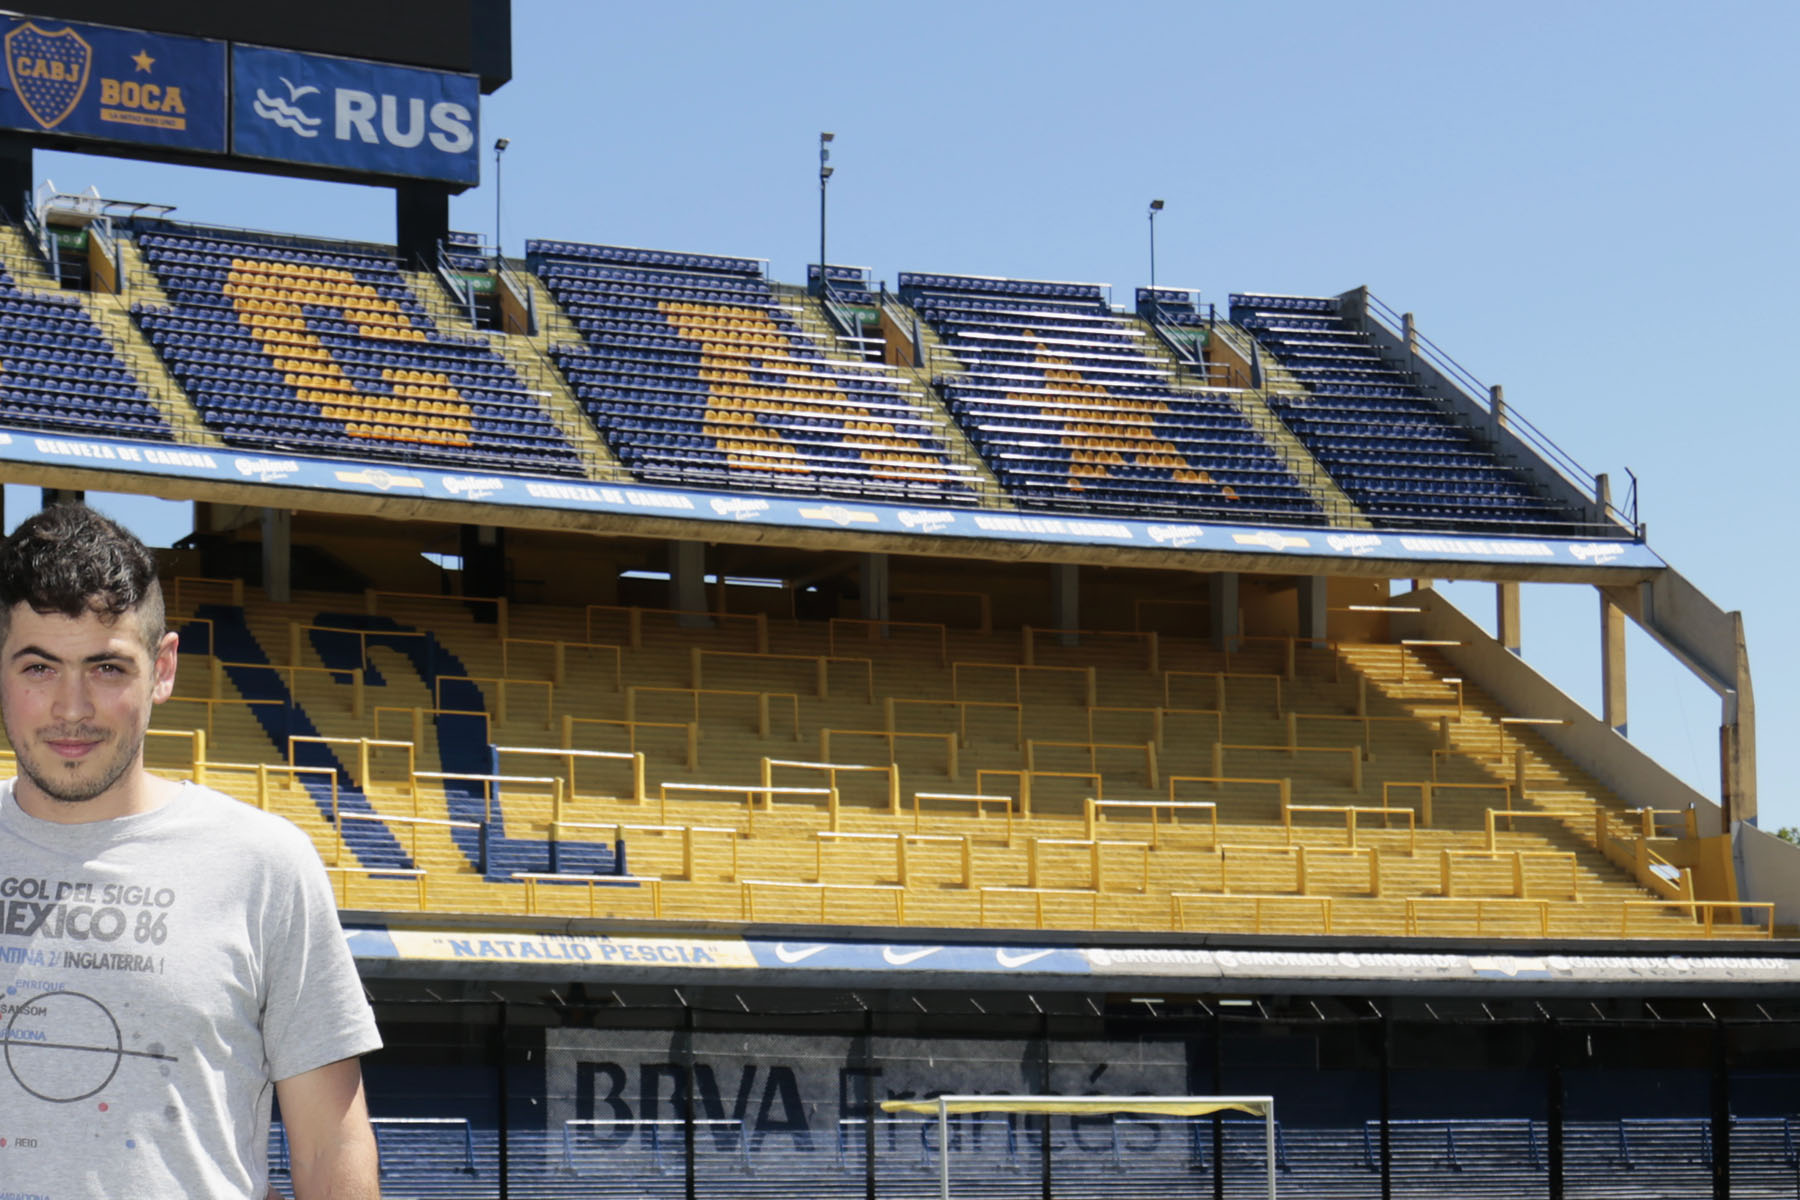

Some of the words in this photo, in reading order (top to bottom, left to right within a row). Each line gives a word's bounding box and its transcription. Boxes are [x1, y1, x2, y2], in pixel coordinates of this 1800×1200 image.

[16, 56, 80, 82] CABJ
[100, 78, 186, 114] BOCA
[335, 87, 474, 154] RUS
[34, 438, 116, 460] CERVEZA
[118, 446, 143, 462] DE
[144, 449, 218, 469] CANCHA
[0, 877, 50, 901] GOL
[55, 881, 96, 904] DEL
[102, 884, 176, 909] SIGLO
[134, 911, 169, 945] 86
[62, 951, 153, 973] INGLATERRA
[15, 979, 65, 993] ENRIQUE
[0, 1004, 47, 1017] SANSOM
[575, 1060, 816, 1154] BBVA
[14, 1138, 38, 1149] REID
